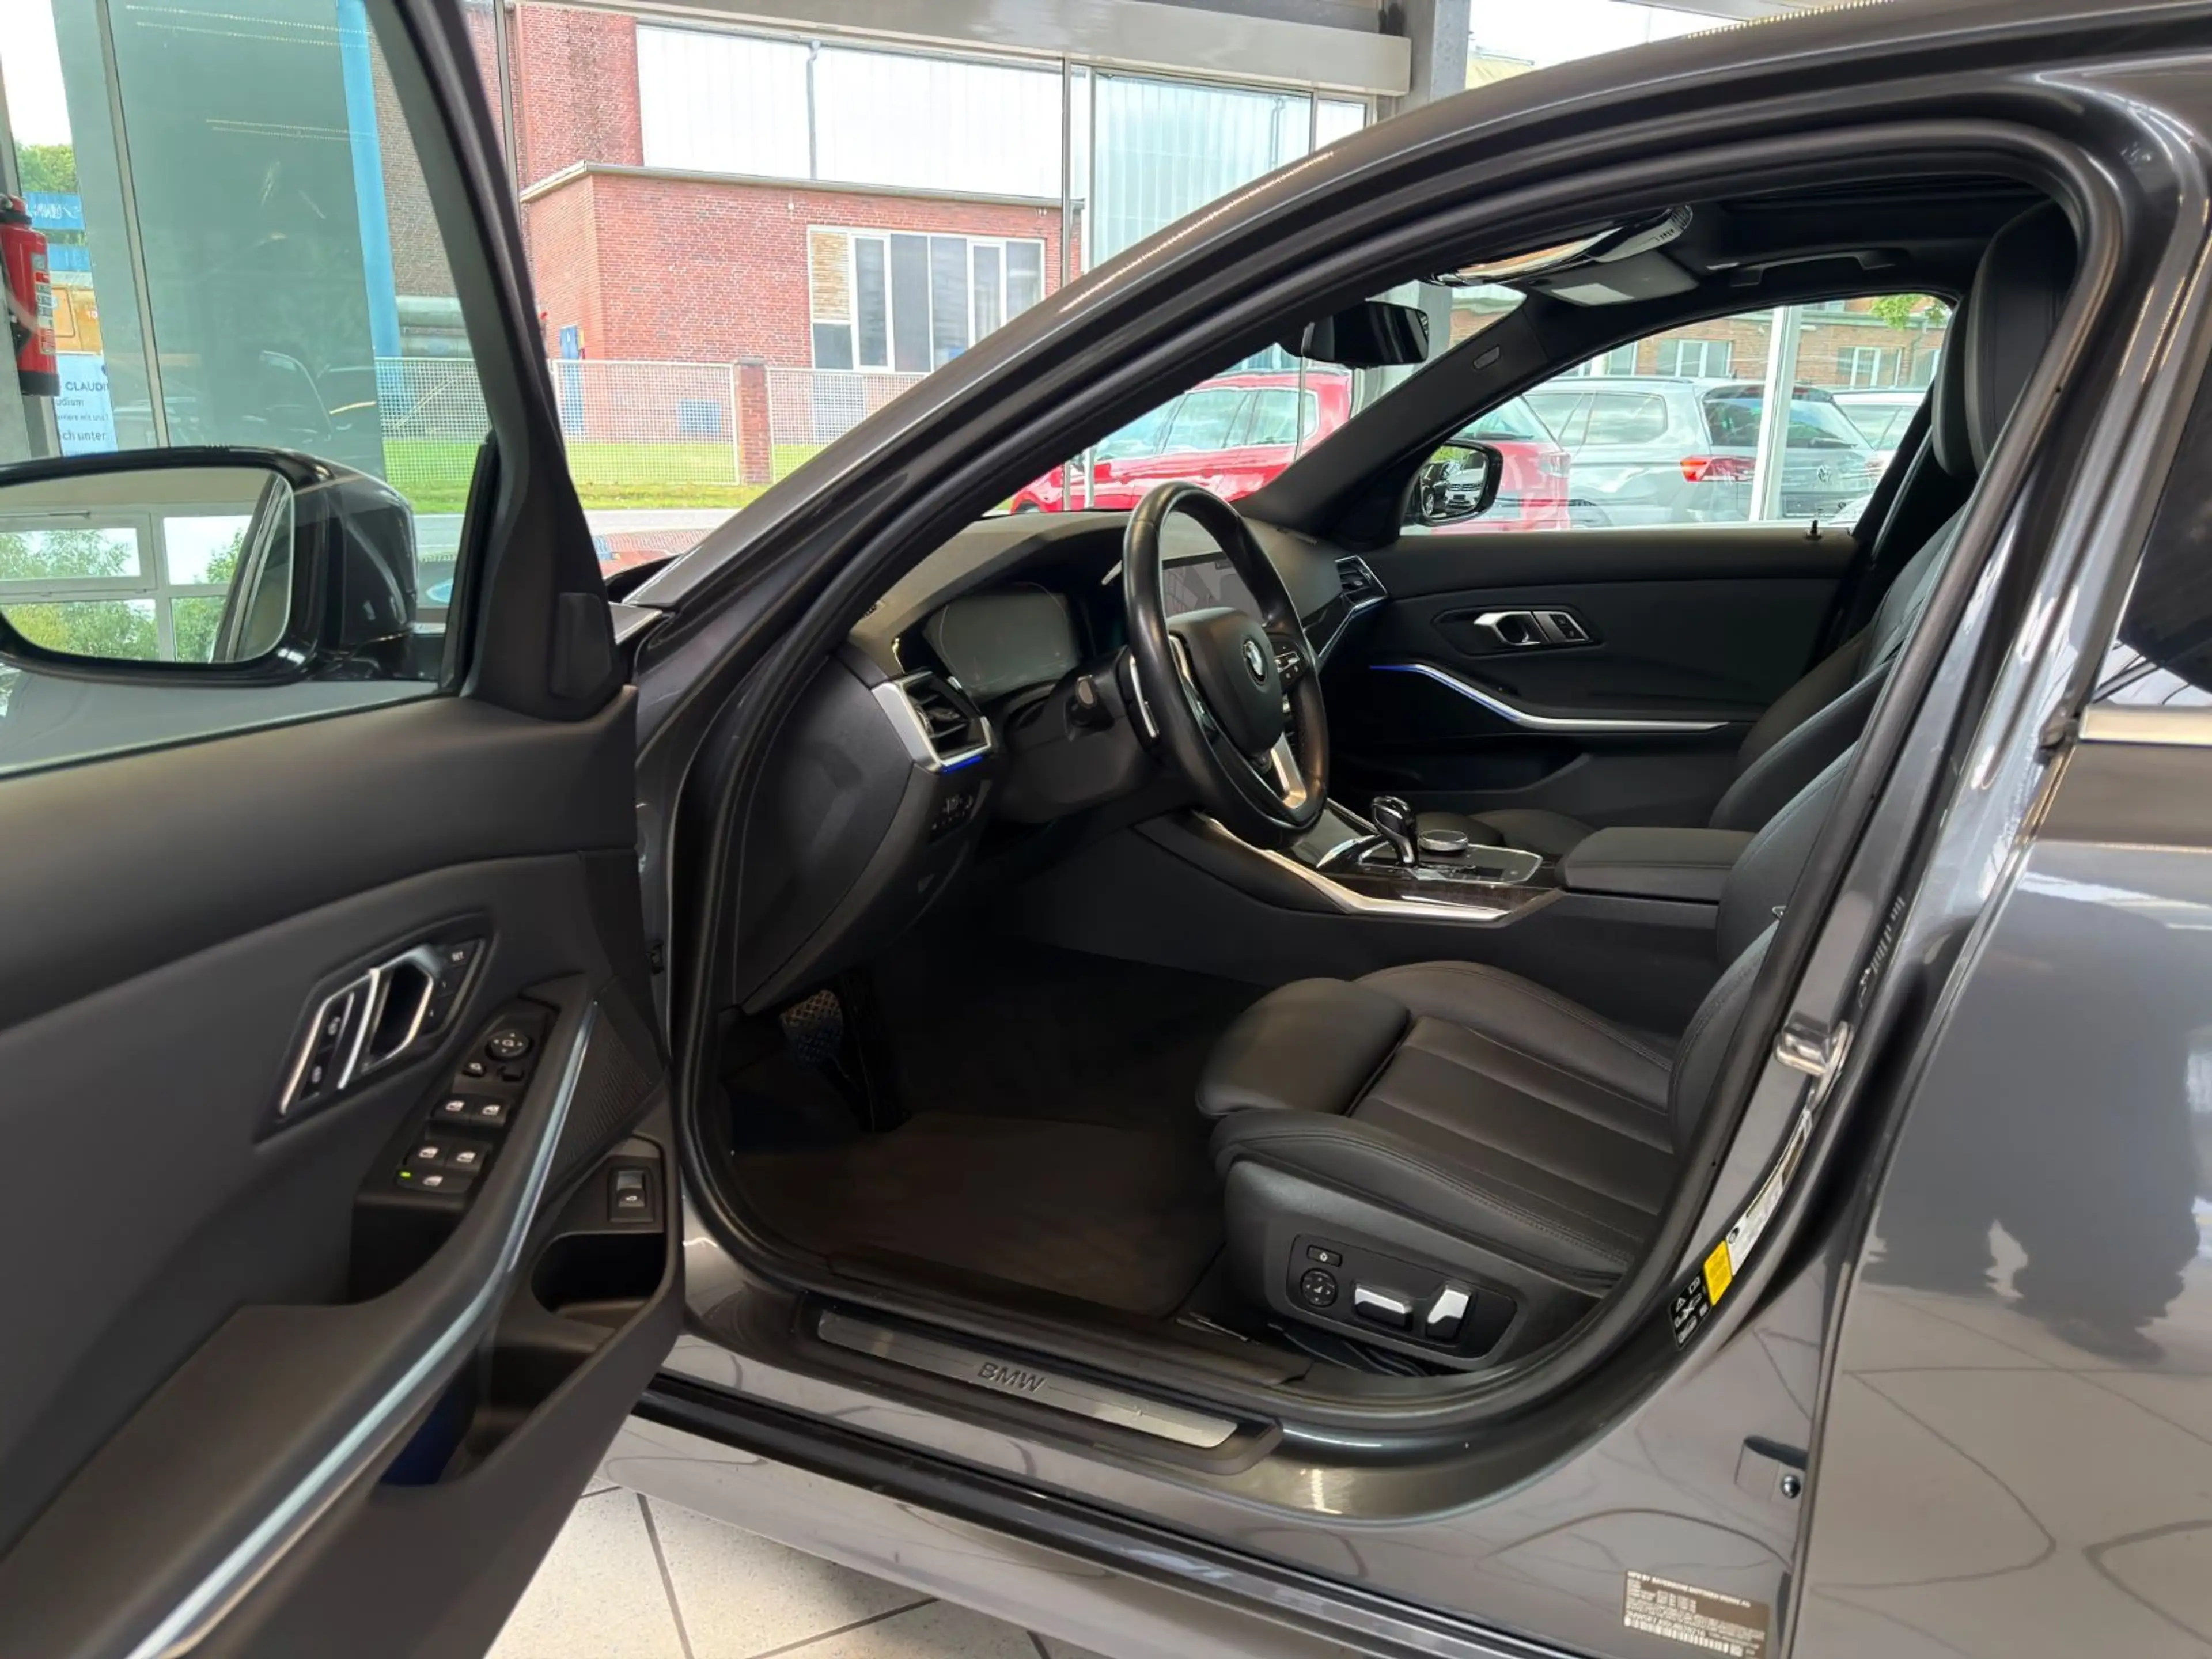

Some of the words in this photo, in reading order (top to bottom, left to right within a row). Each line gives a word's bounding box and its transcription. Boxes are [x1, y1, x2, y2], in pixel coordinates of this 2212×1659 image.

[65, 381, 108, 391] CLAUDI
[77, 431, 106, 441] unter
[978, 1362, 1047, 1392] BMW
